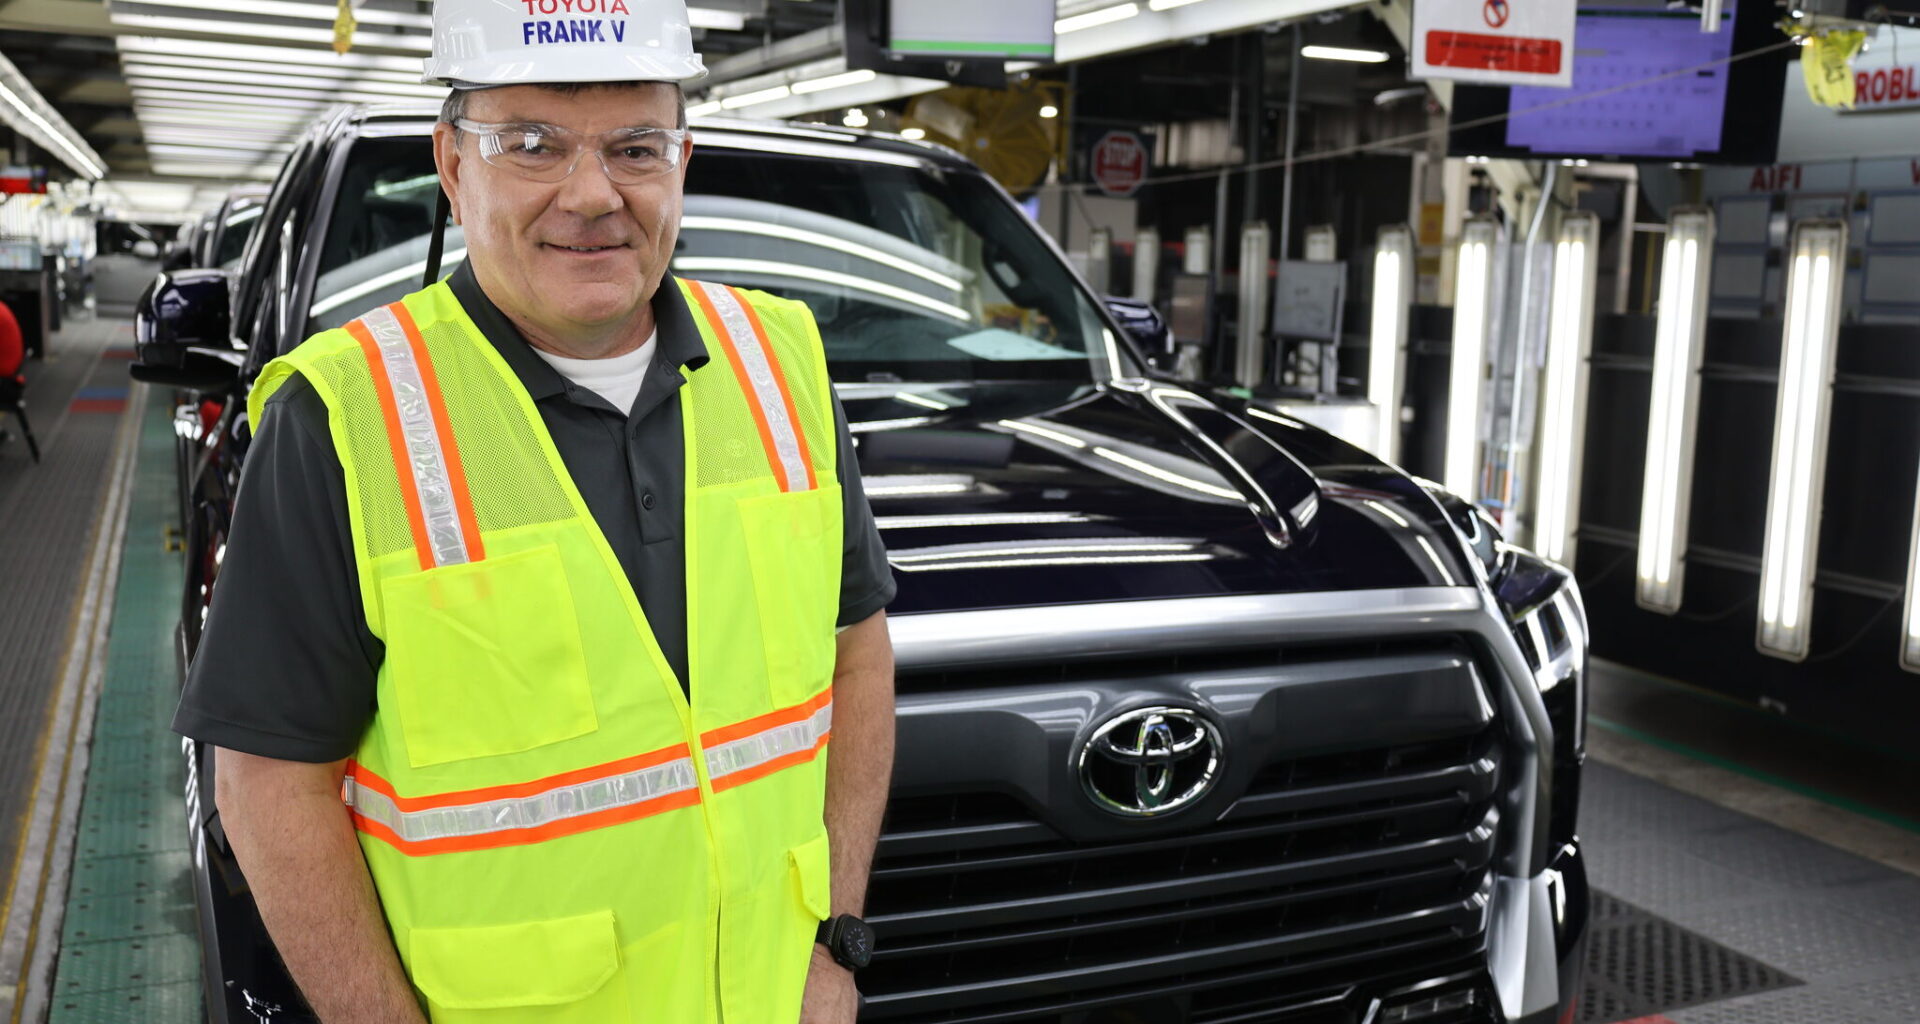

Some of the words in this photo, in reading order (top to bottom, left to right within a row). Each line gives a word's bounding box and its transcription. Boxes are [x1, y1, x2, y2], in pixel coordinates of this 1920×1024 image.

[522, 0, 630, 16] TOYOTA
[523, 19, 605, 45] FRANK
[610, 20, 625, 43] V
[1855, 66, 1920, 104] ROBL
